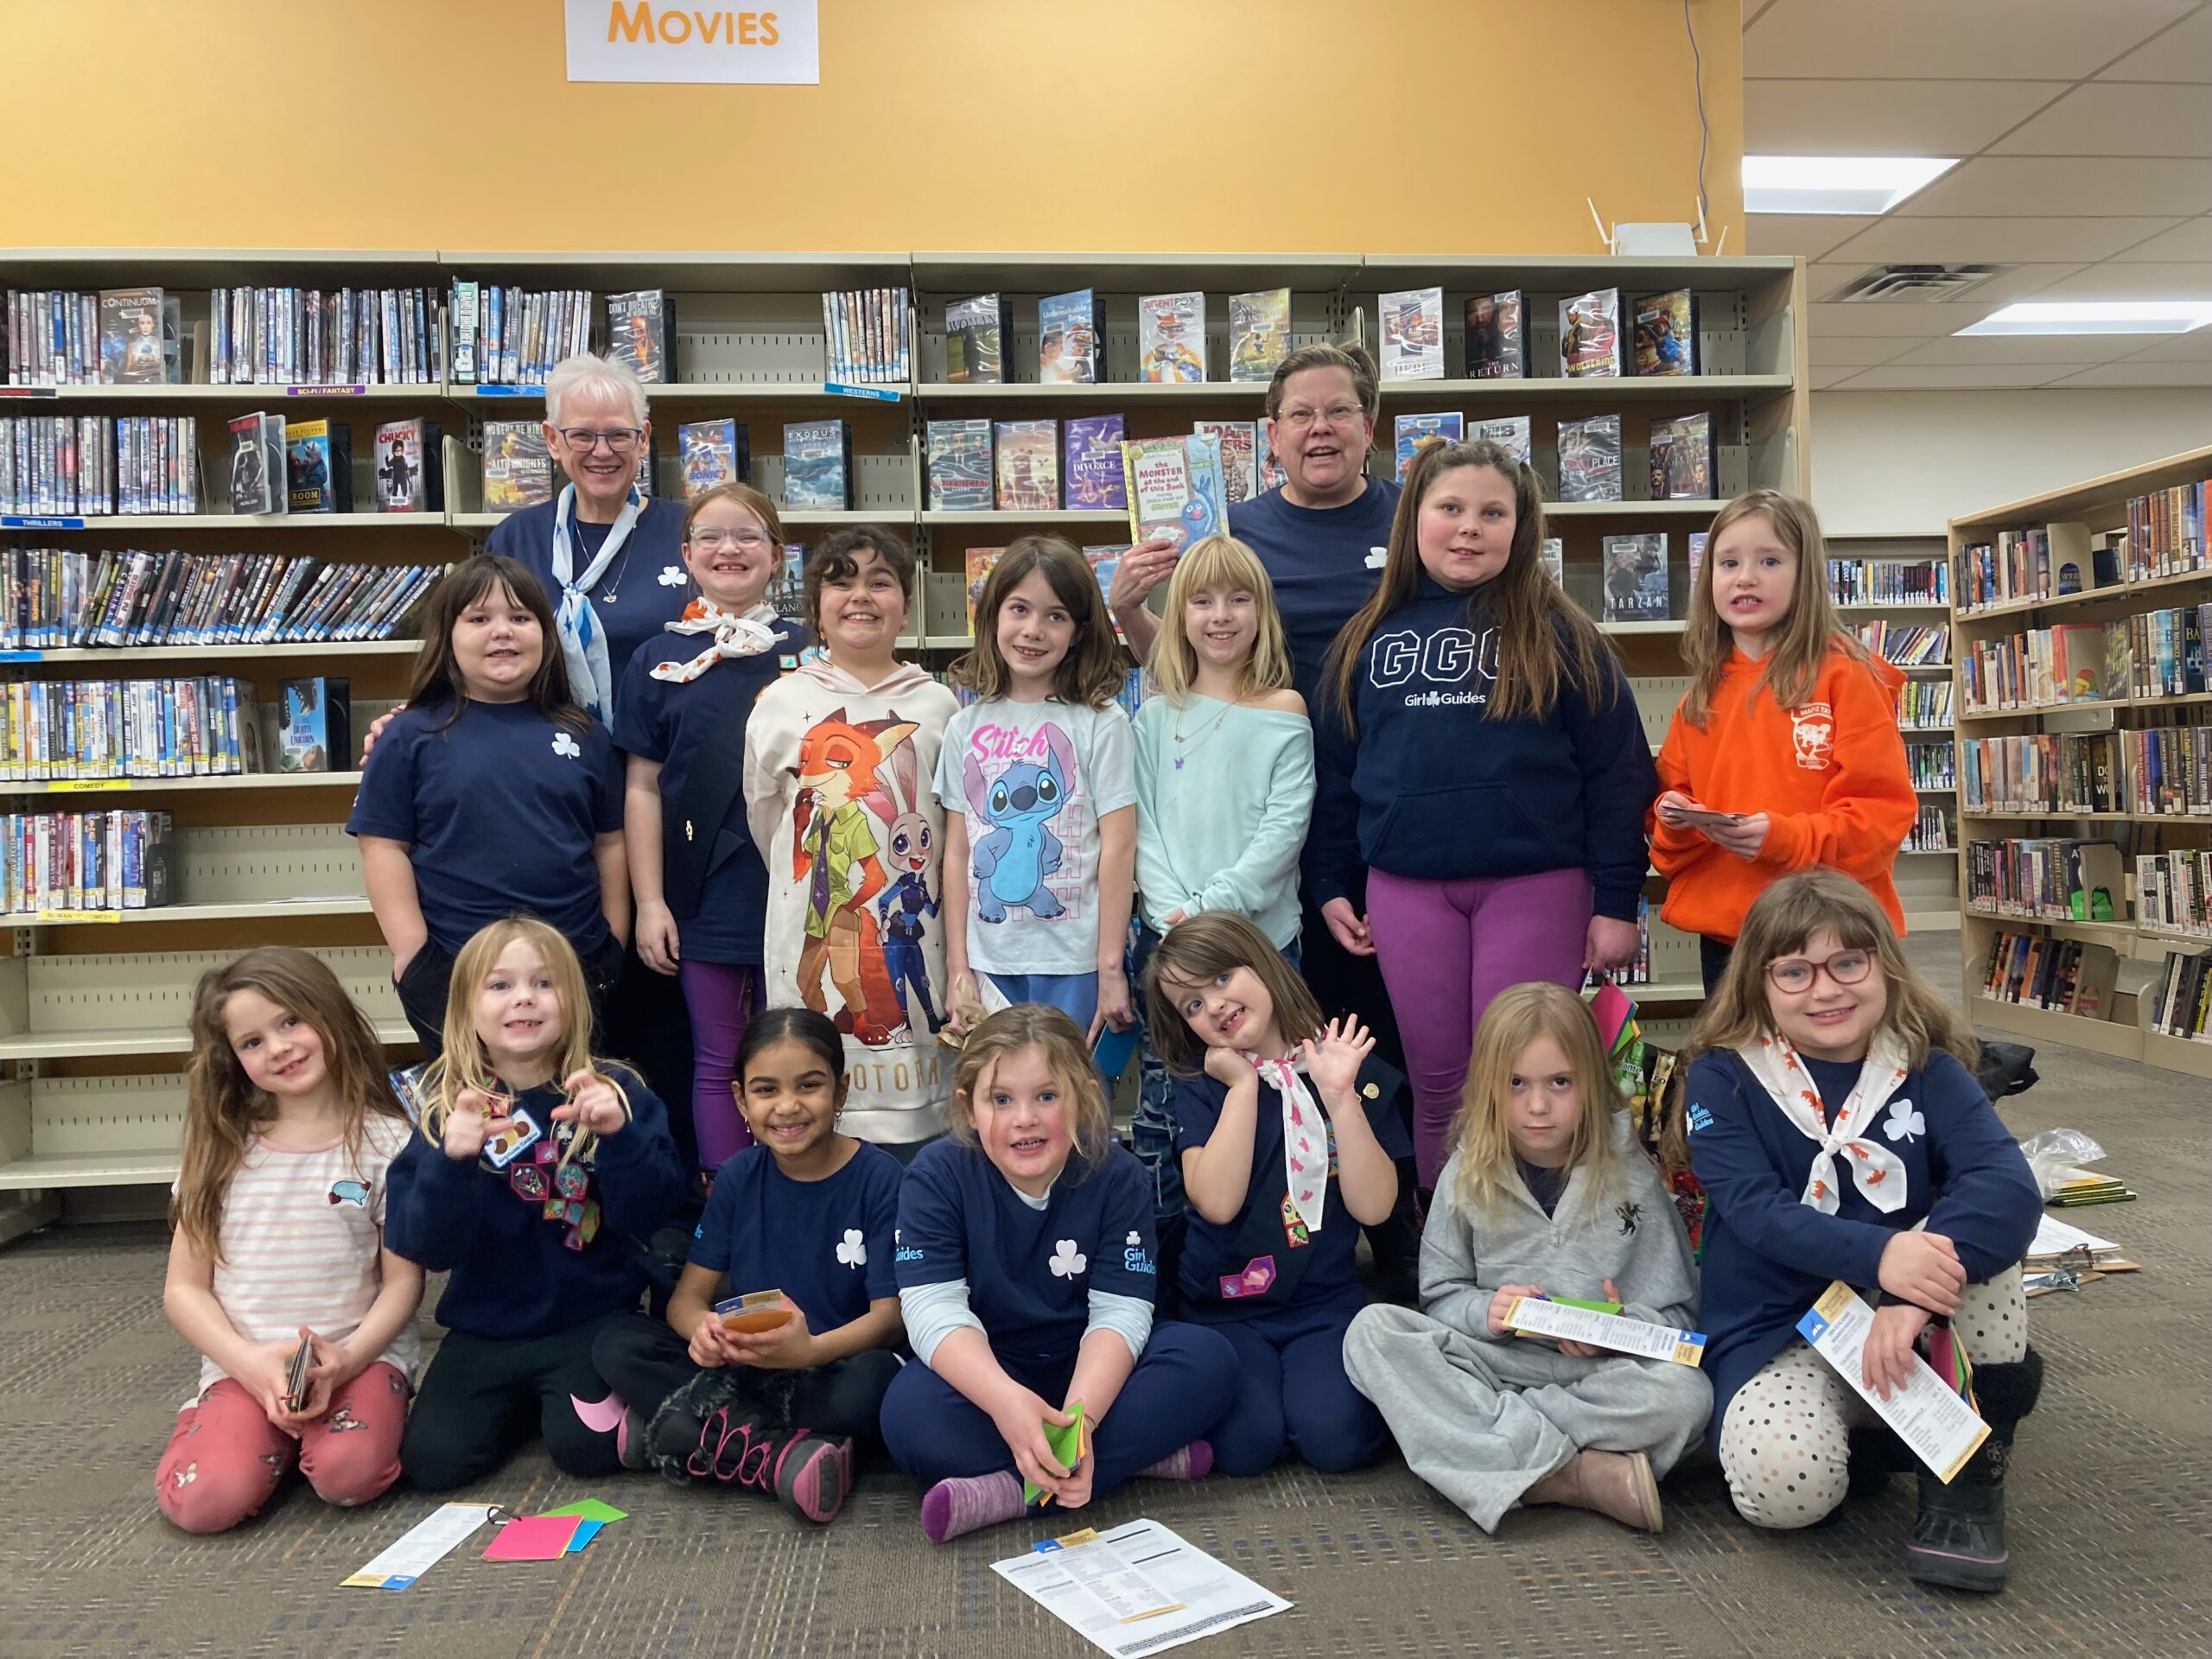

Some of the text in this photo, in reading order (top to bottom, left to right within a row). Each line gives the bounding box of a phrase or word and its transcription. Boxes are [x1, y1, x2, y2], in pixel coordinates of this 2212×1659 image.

[607, 0, 779, 46] MOVIES
[101, 297, 157, 308] CONTINUUM
[609, 302, 626, 315] DON'T
[1143, 296, 1196, 309] AGENT FOX
[1043, 303, 1088, 319] Unbreakable
[948, 314, 997, 332] WOMAN
[1470, 362, 1519, 378] RETURN
[1567, 354, 1615, 373] WOLVERINE
[842, 386, 880, 397] WESTERNS
[378, 429, 416, 443] CHUCKY
[788, 429, 836, 439] EXODUS
[1072, 461, 1116, 472] DIVORCE
[1591, 455, 1618, 468] PLACE
[689, 468, 727, 480] SONIC 3
[1139, 467, 1183, 479] MONSTER
[291, 491, 319, 500] ROOM
[105, 573, 127, 622] CRIMINAL
[1610, 596, 1662, 610] TARZAN
[1405, 691, 1486, 707] Girl Guides
[188, 700, 197, 732] WELCOME
[970, 722, 1048, 764] Stitch
[1124, 1247, 1147, 1263] Girl
